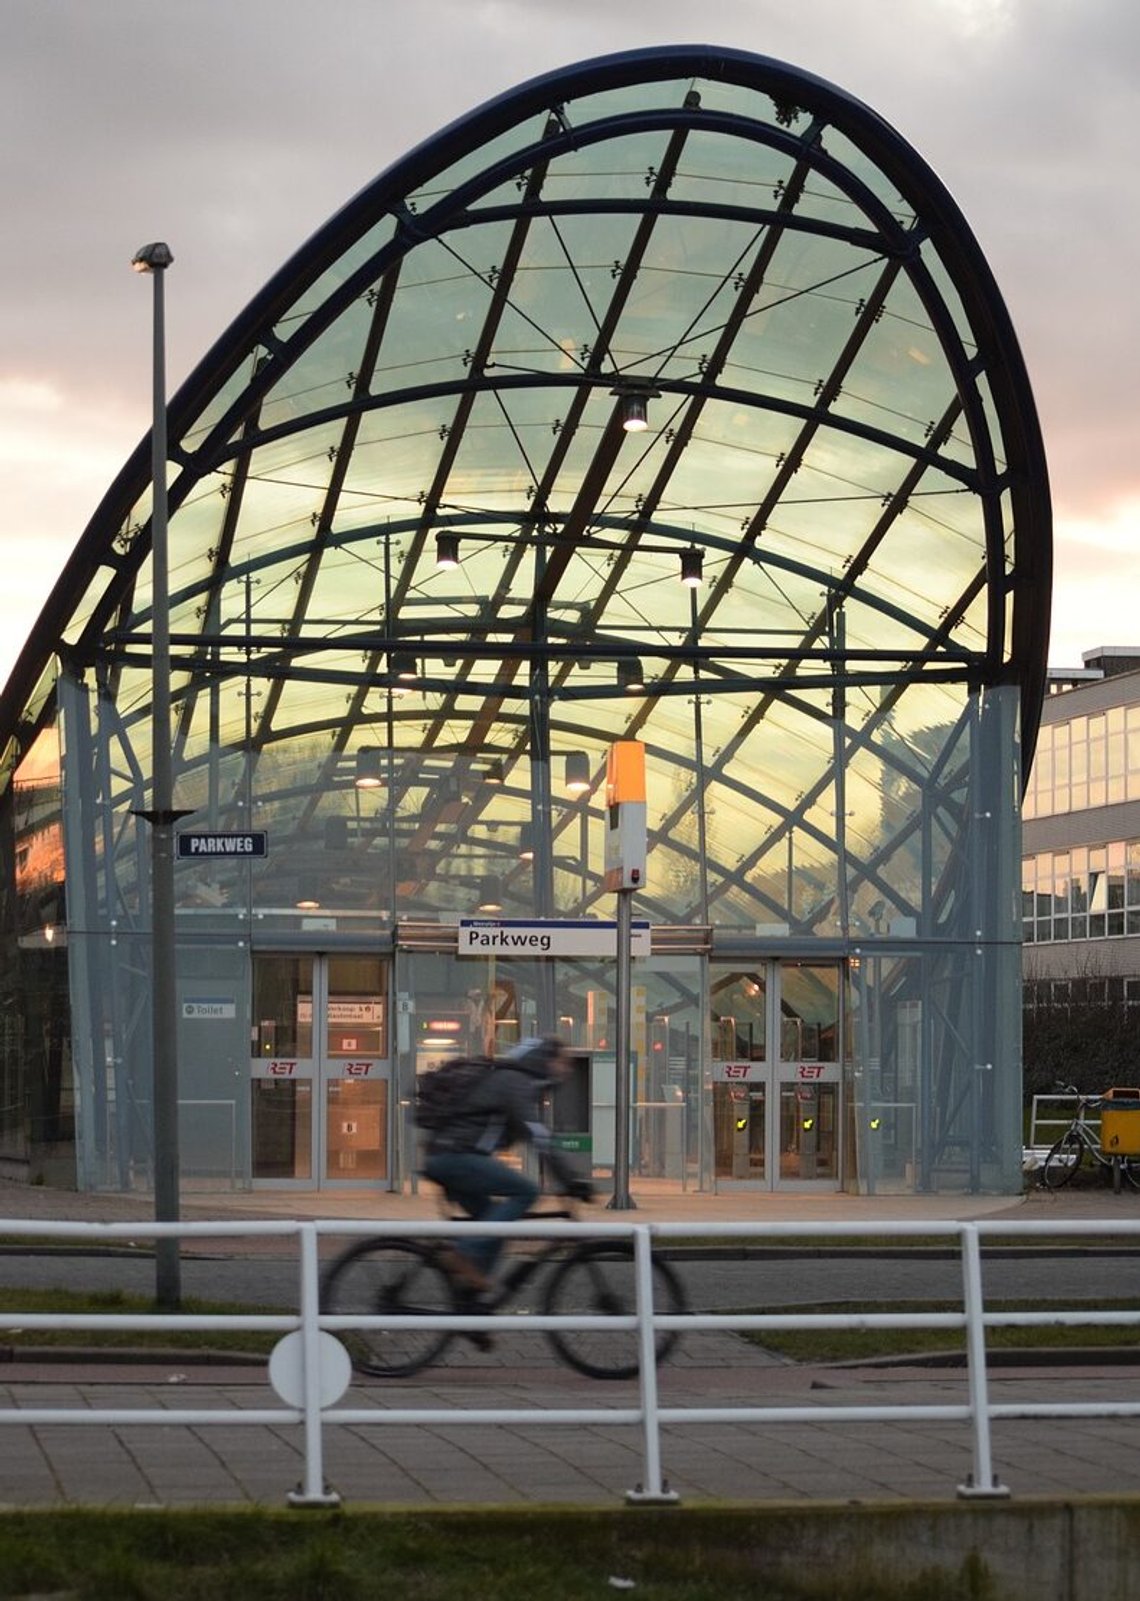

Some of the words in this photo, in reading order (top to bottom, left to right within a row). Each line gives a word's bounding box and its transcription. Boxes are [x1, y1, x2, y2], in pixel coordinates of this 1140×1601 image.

[190, 836, 254, 853] PARKWEG
[468, 930, 552, 951] Parkweg
[269, 1062, 297, 1075] RET
[345, 1062, 373, 1076] RET
[725, 1065, 751, 1078] RET
[799, 1065, 825, 1079] RET
